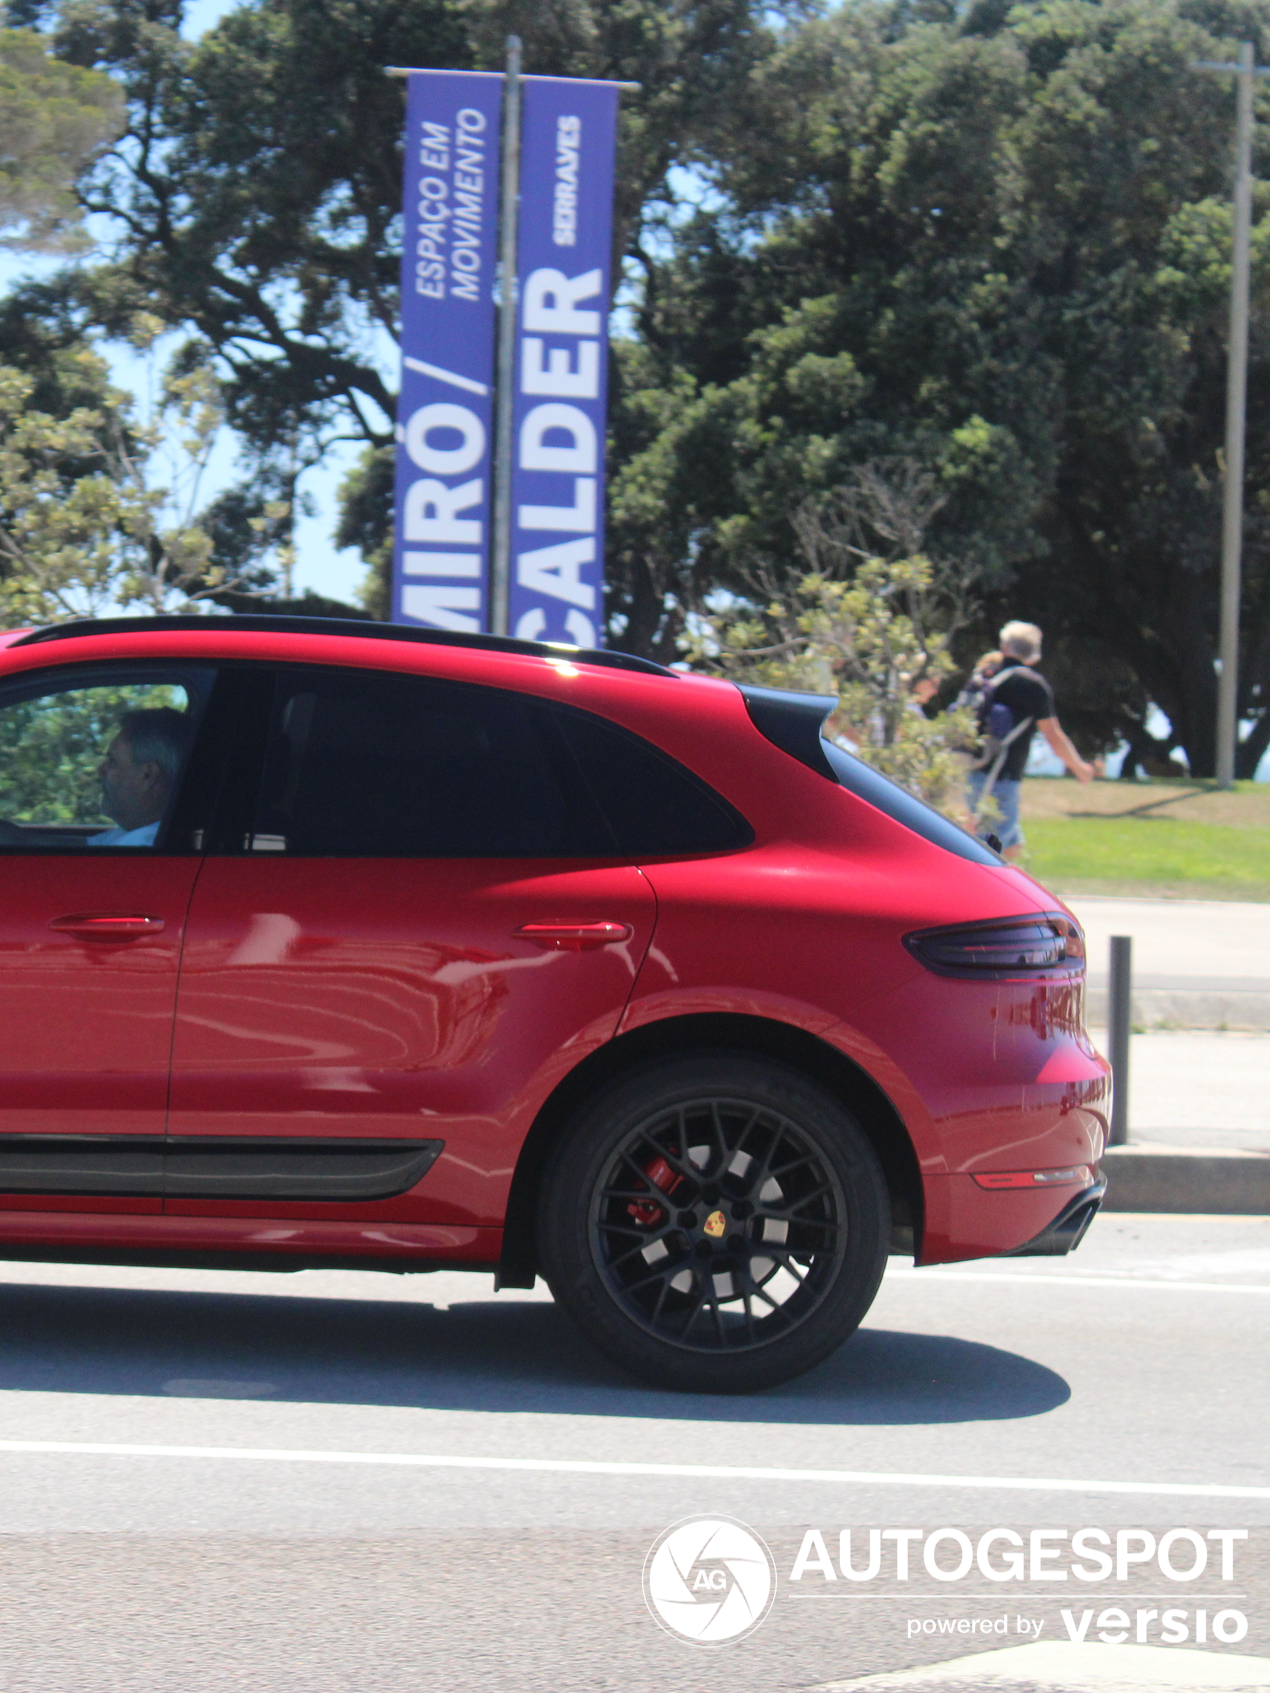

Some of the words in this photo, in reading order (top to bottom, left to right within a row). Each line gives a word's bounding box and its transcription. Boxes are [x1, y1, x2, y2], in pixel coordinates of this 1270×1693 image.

[420, 120, 450, 171] EM
[450, 107, 487, 301] MOVIMENTO
[415, 176, 452, 299] ESPAÇO
